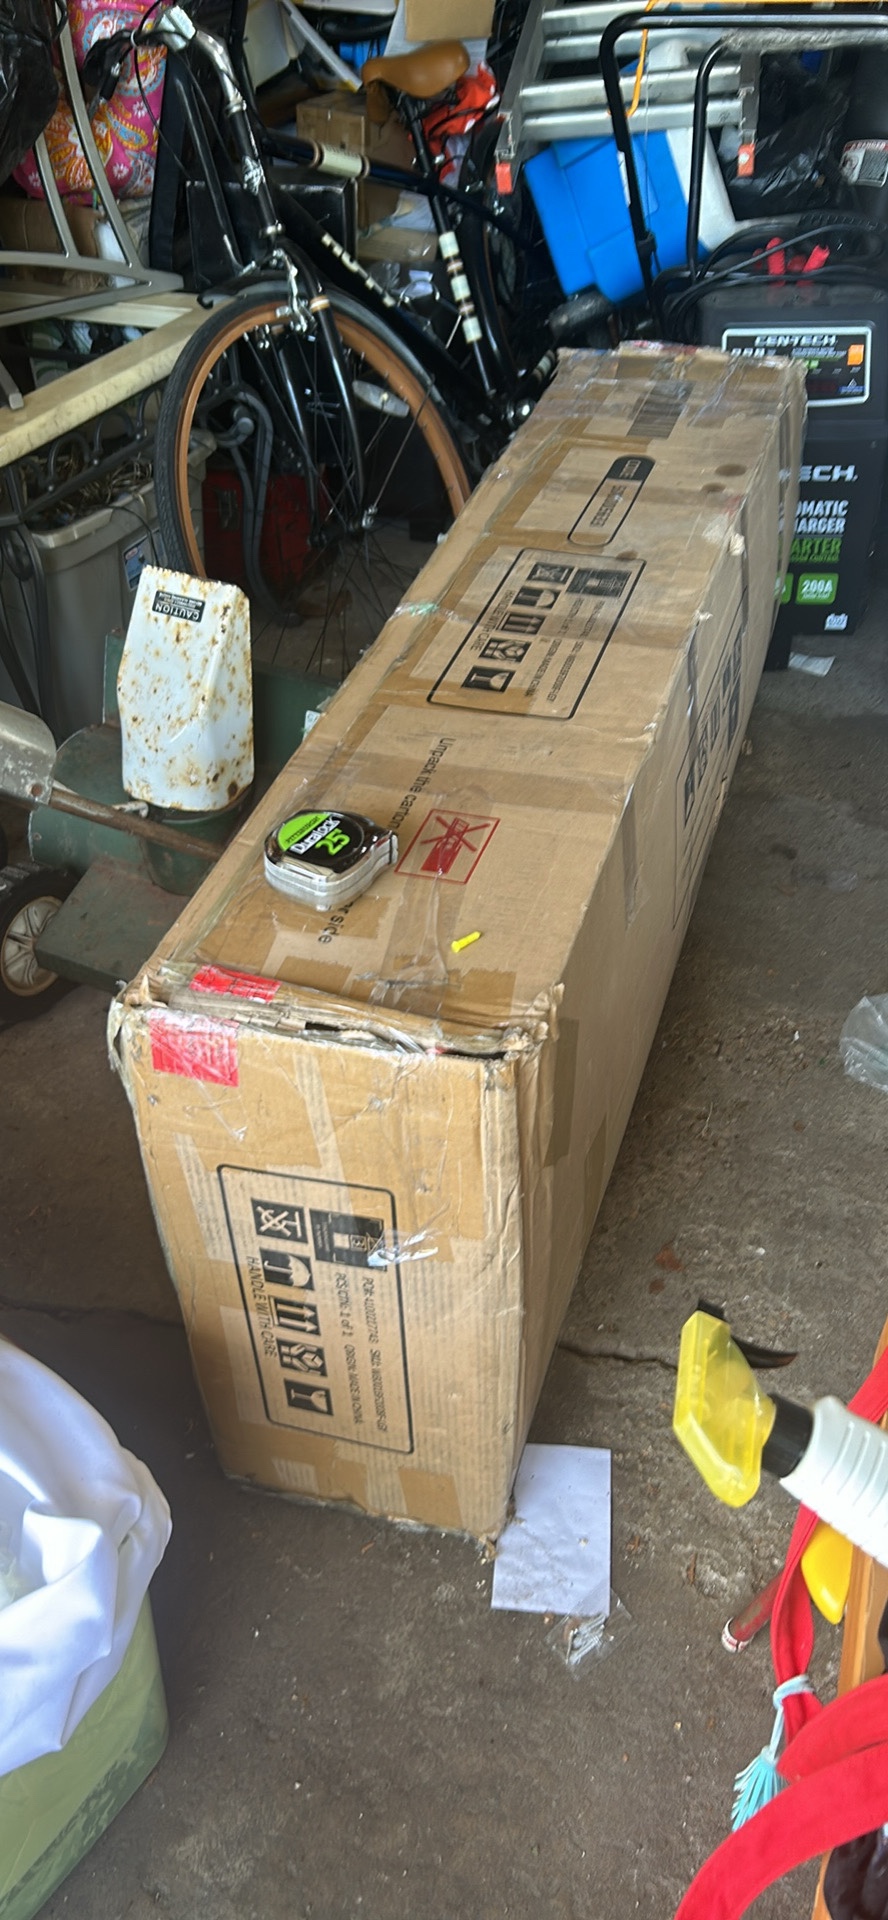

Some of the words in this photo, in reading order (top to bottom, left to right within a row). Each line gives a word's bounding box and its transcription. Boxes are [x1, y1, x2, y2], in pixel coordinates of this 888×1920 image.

[802, 579, 833, 592] 200A
[155, 602, 200, 620] CAUTION
[470, 632, 489, 651] CARE
[420, 737, 456, 776] Unpack
[410, 774, 430, 793] the
[388, 793, 417, 829] carton
[318, 915, 345, 943] side
[247, 1256, 267, 1300] HANDLE
[256, 1302, 274, 1329] WITH
[261, 1329, 277, 1358] CARE
